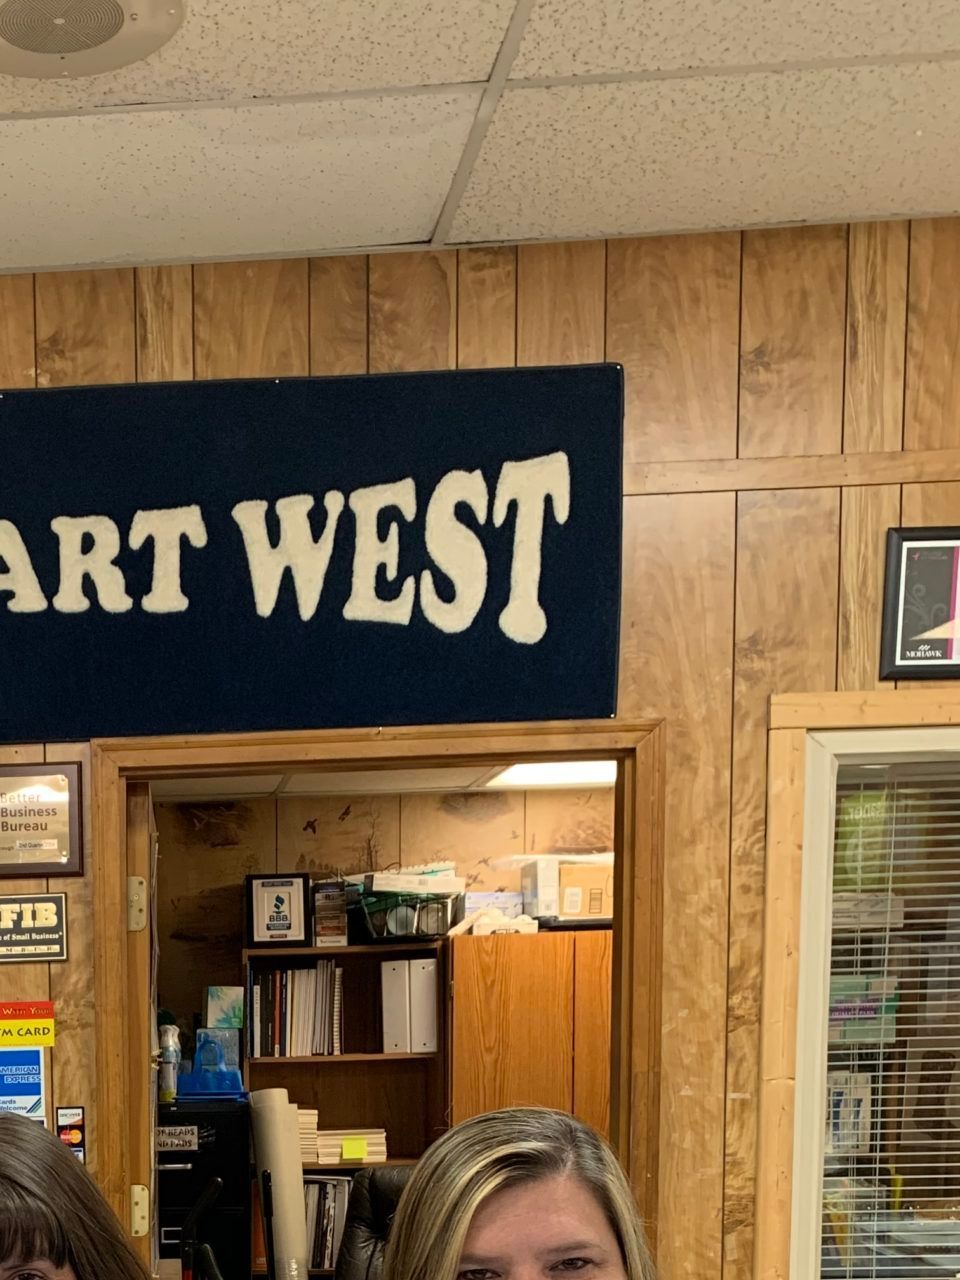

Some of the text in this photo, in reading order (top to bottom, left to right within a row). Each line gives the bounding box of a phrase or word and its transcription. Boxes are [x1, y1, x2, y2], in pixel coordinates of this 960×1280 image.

[232, 452, 570, 644] WEST
[906, 650, 942, 658] MOHAWK
[0, 792, 40, 803] Better
[0, 806, 58, 817] Business
[1, 821, 48, 832] Bureau
[269, 914, 288, 922] BBB
[3, 933, 11, 941] of
[12, 932, 30, 940] Small
[17, 1026, 51, 1037] CARD
[4, 1074, 41, 1084] EXPRESS
